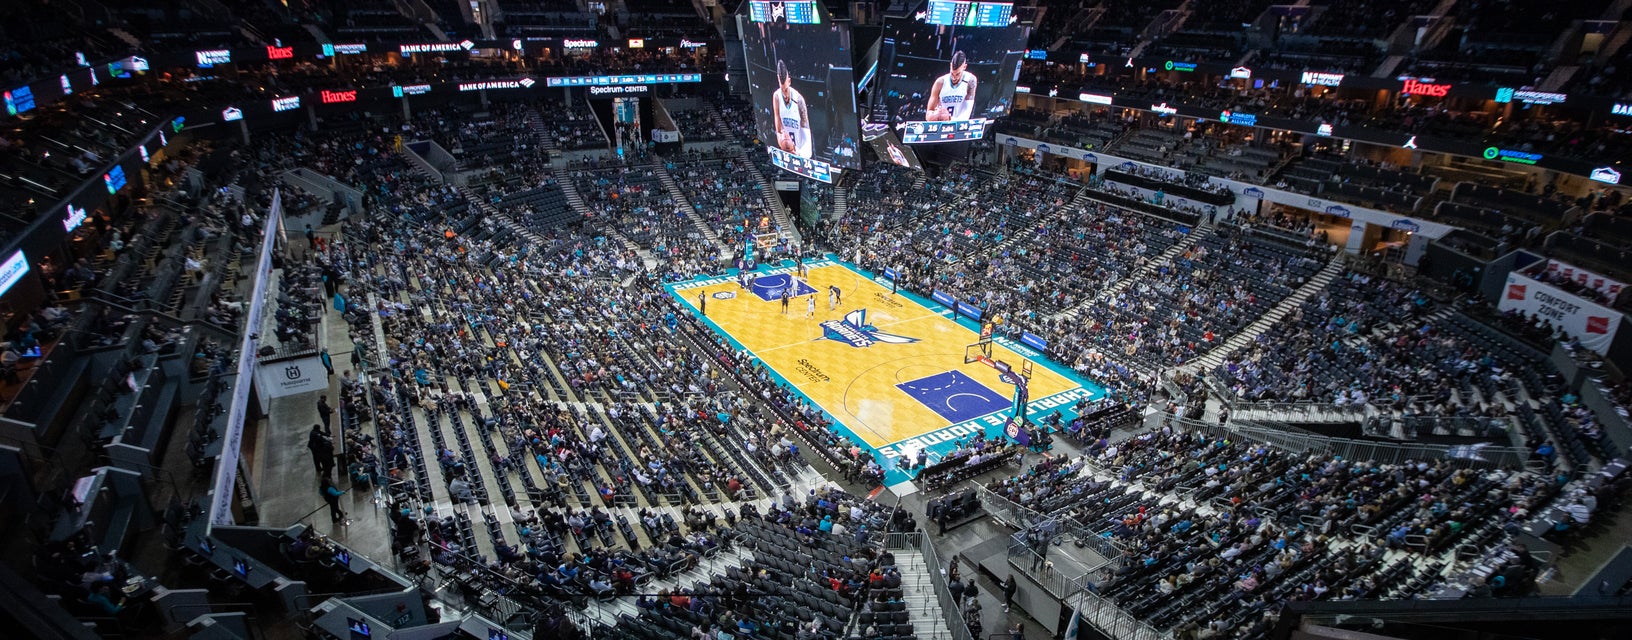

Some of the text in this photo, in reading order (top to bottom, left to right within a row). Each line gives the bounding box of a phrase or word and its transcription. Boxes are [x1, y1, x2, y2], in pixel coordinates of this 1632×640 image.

[431, 43, 461, 51] AMERICA
[564, 39, 596, 49] Spectrum
[266, 45, 293, 59] Hanes
[486, 81, 519, 89] AMERICA
[1402, 79, 1450, 97] Hanes
[321, 90, 356, 103] Hanes
[590, 86, 647, 96] Spectrum CENTER
[1231, 111, 1256, 120] CHARLOTTE
[927, 124, 938, 132] 16
[958, 123, 968, 131] 24
[1230, 118, 1255, 127] ALLIANCE
[1534, 291, 1581, 315] COMFORT
[1538, 304, 1566, 321] ZONE
[822, 320, 873, 347] HORNETS
[795, 366, 821, 383] CENTER
[797, 358, 830, 382] Spectrum
[280, 378, 311, 386] Husqvarna
